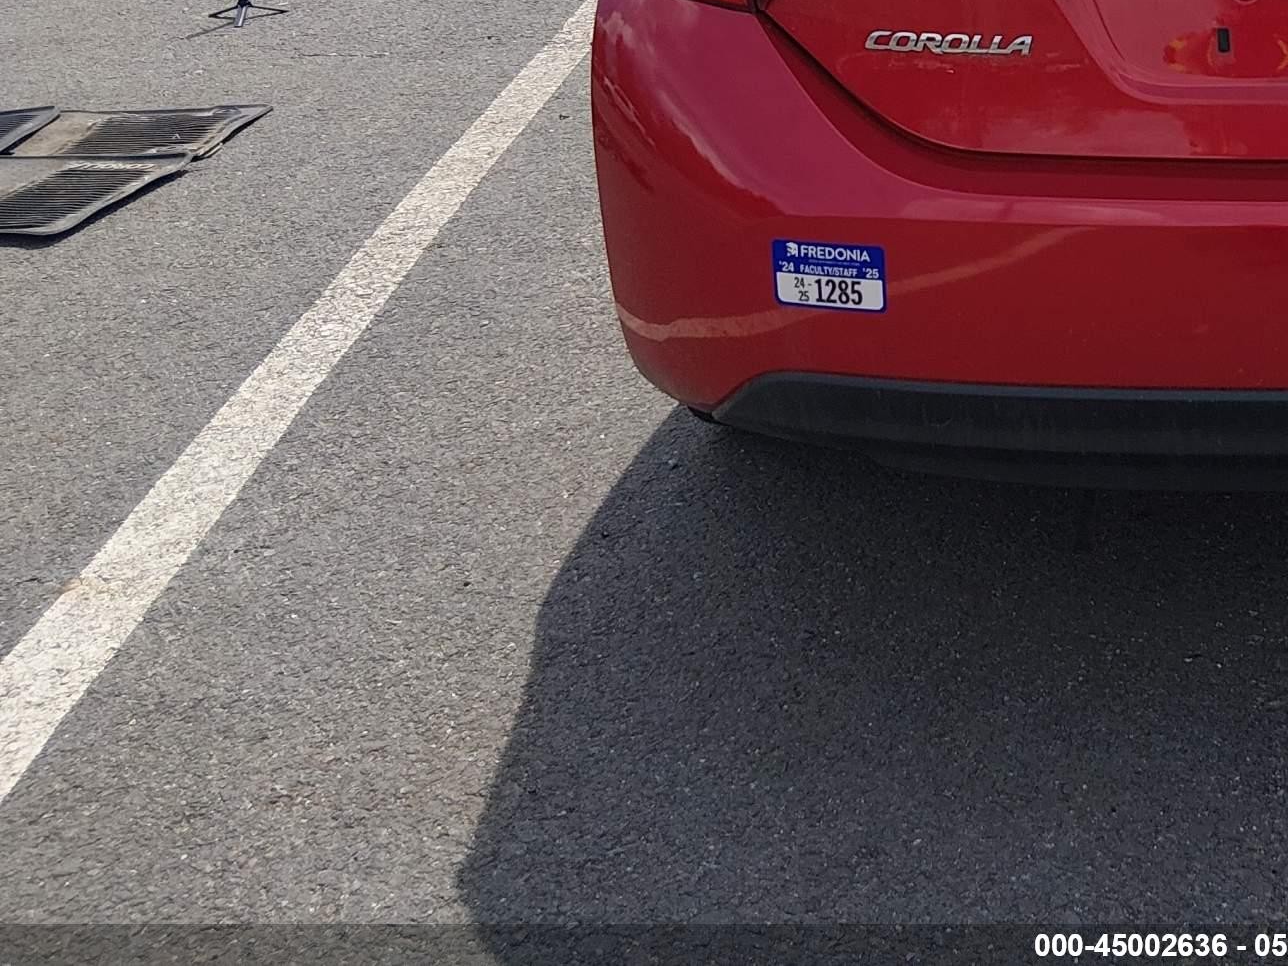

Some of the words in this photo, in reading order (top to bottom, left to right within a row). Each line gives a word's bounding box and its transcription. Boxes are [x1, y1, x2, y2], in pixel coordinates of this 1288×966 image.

[864, 29, 1033, 56] COROLLA
[800, 245, 870, 262] FREDONIA
[800, 265, 857, 277] FACULTY/STAFF
[799, 290, 810, 302] 25
[815, 278, 863, 305] 1285
